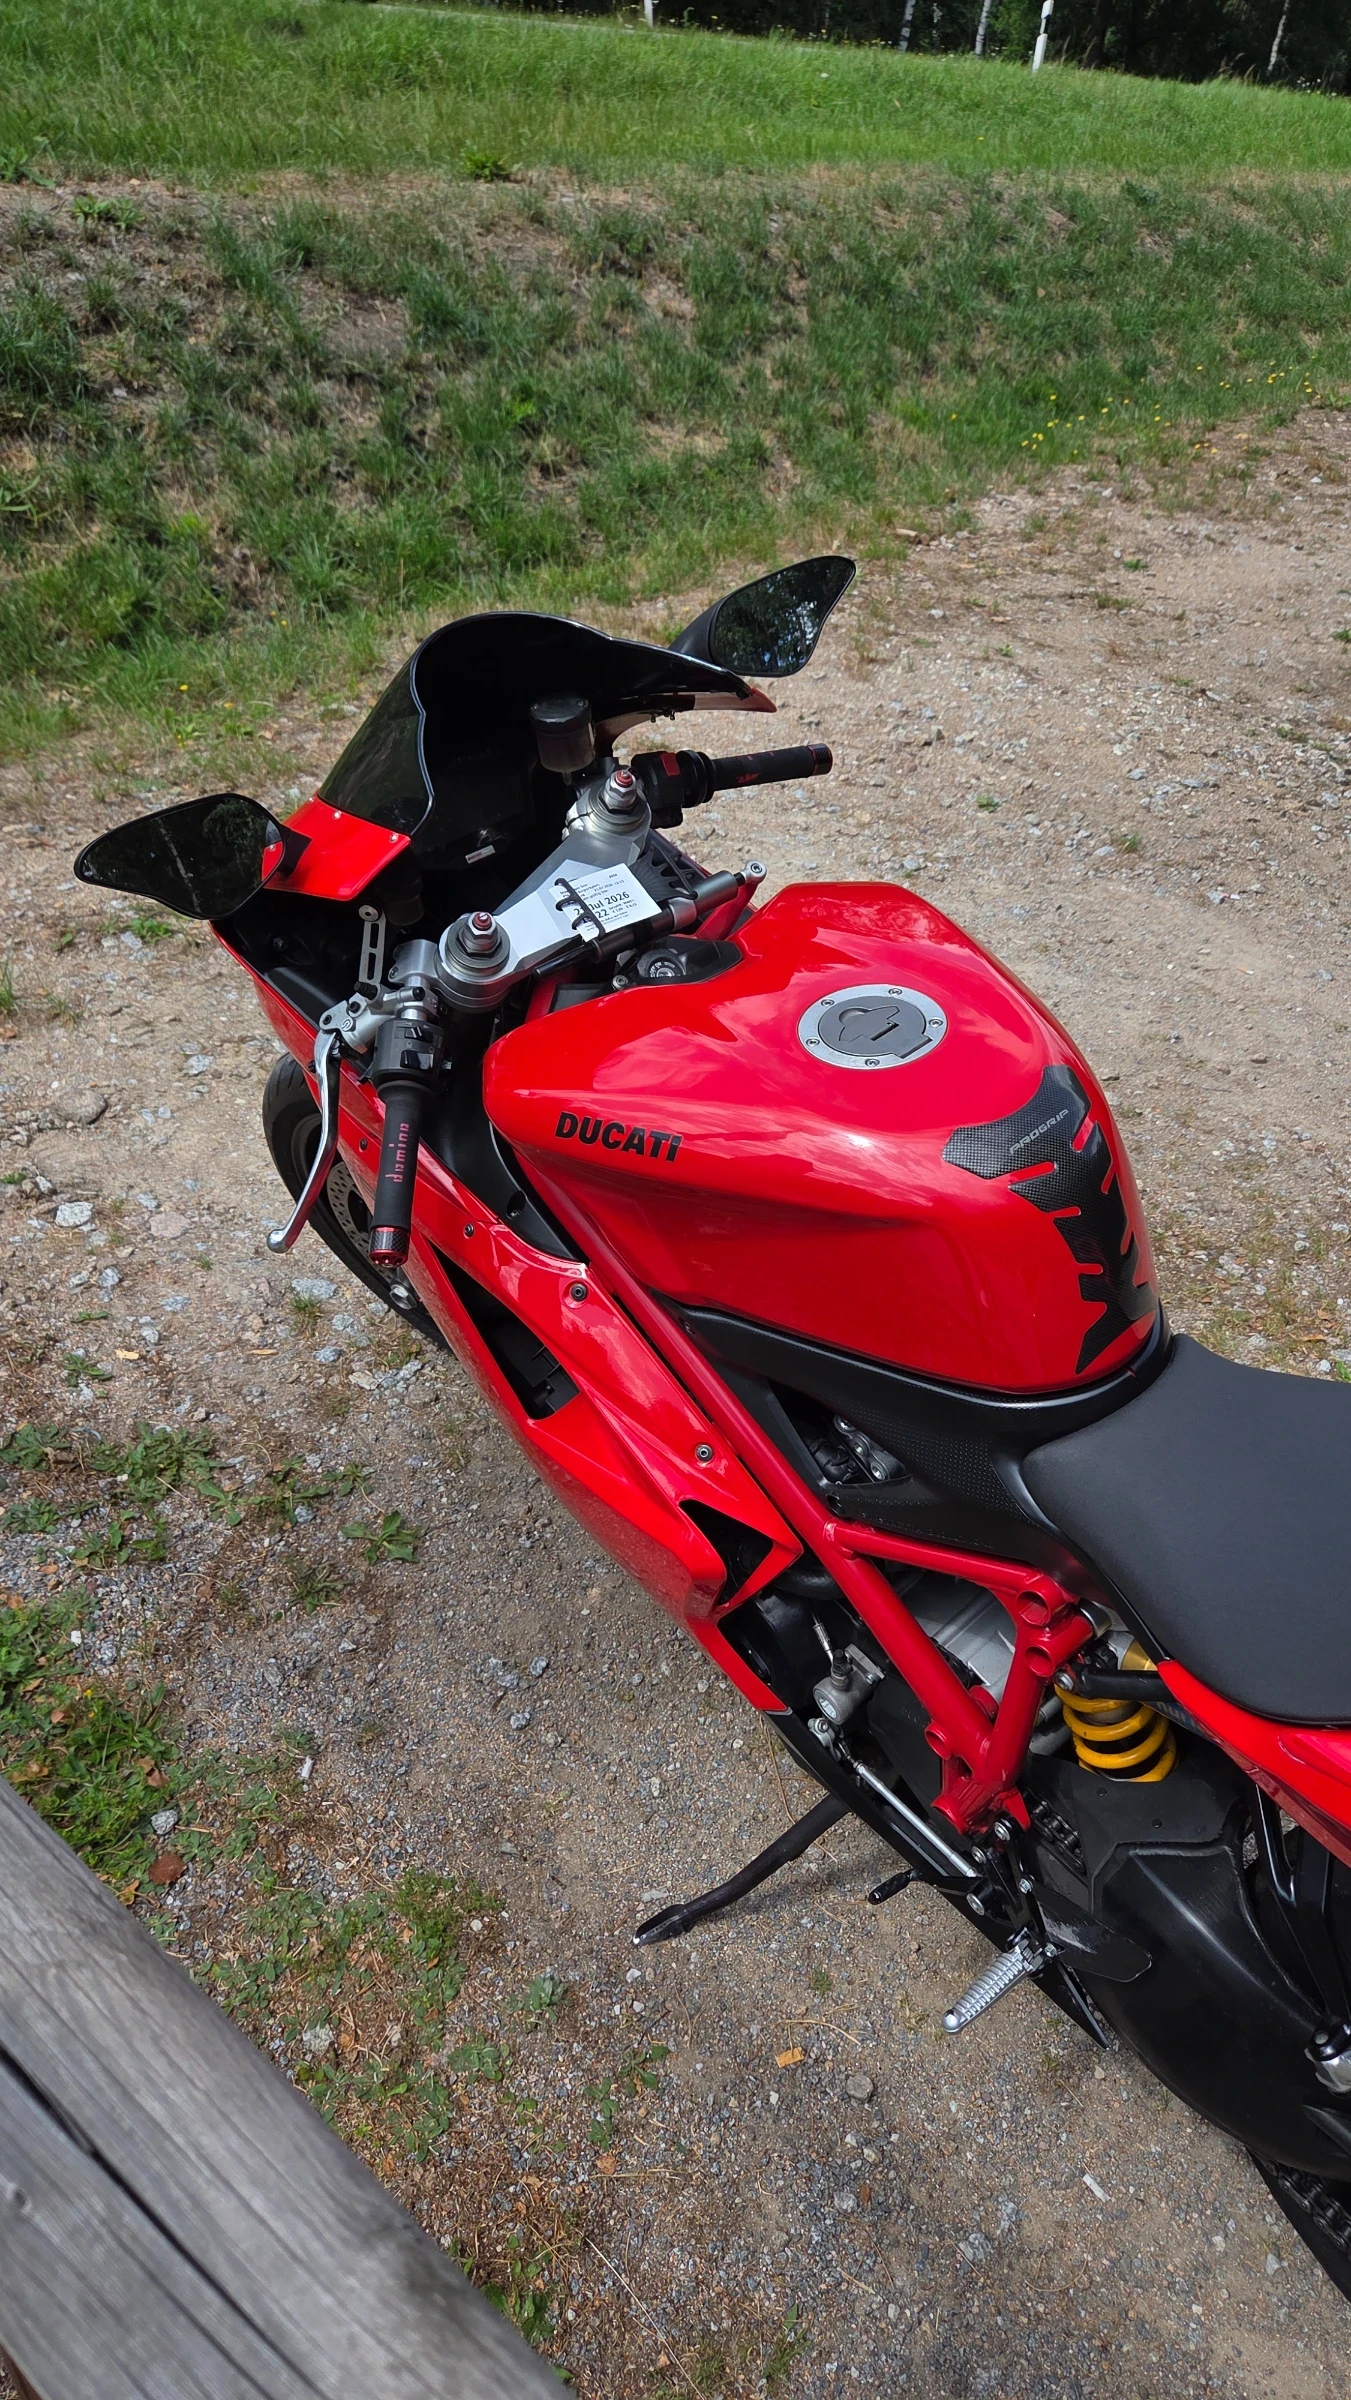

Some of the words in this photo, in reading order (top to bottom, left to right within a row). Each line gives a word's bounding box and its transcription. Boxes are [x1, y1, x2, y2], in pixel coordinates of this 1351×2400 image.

[604, 891, 630, 905] 2026
[385, 1122, 409, 1182] domino
[555, 1111, 683, 1162] DUCATI
[1010, 1109, 1069, 1154] PROGRIP
